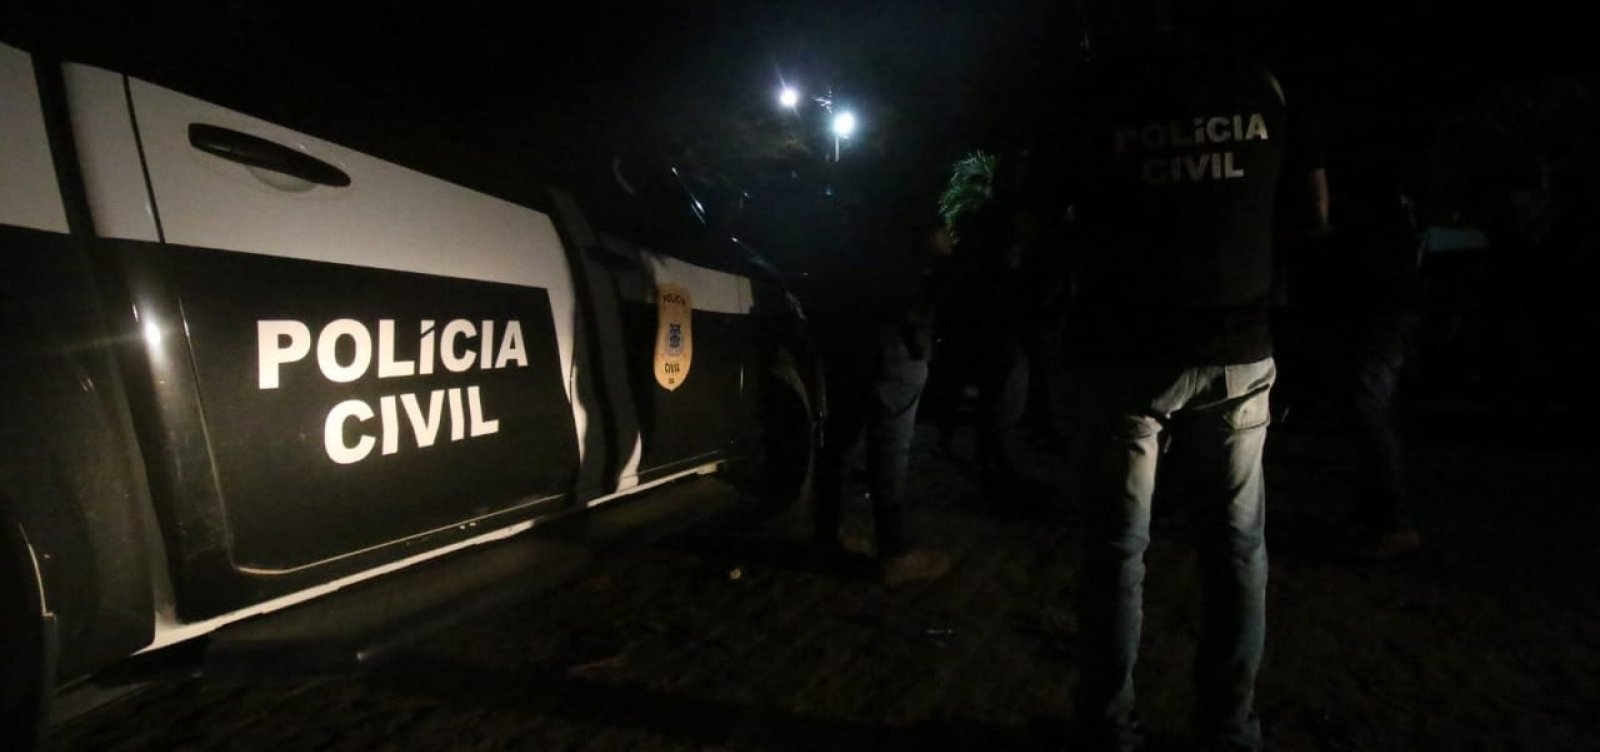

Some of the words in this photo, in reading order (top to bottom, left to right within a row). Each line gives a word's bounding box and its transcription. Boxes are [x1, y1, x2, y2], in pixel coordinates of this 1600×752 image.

[1140, 151, 1246, 184] CIVIL
[258, 319, 528, 390] POLÍCIA
[323, 386, 499, 464] CIVIL
